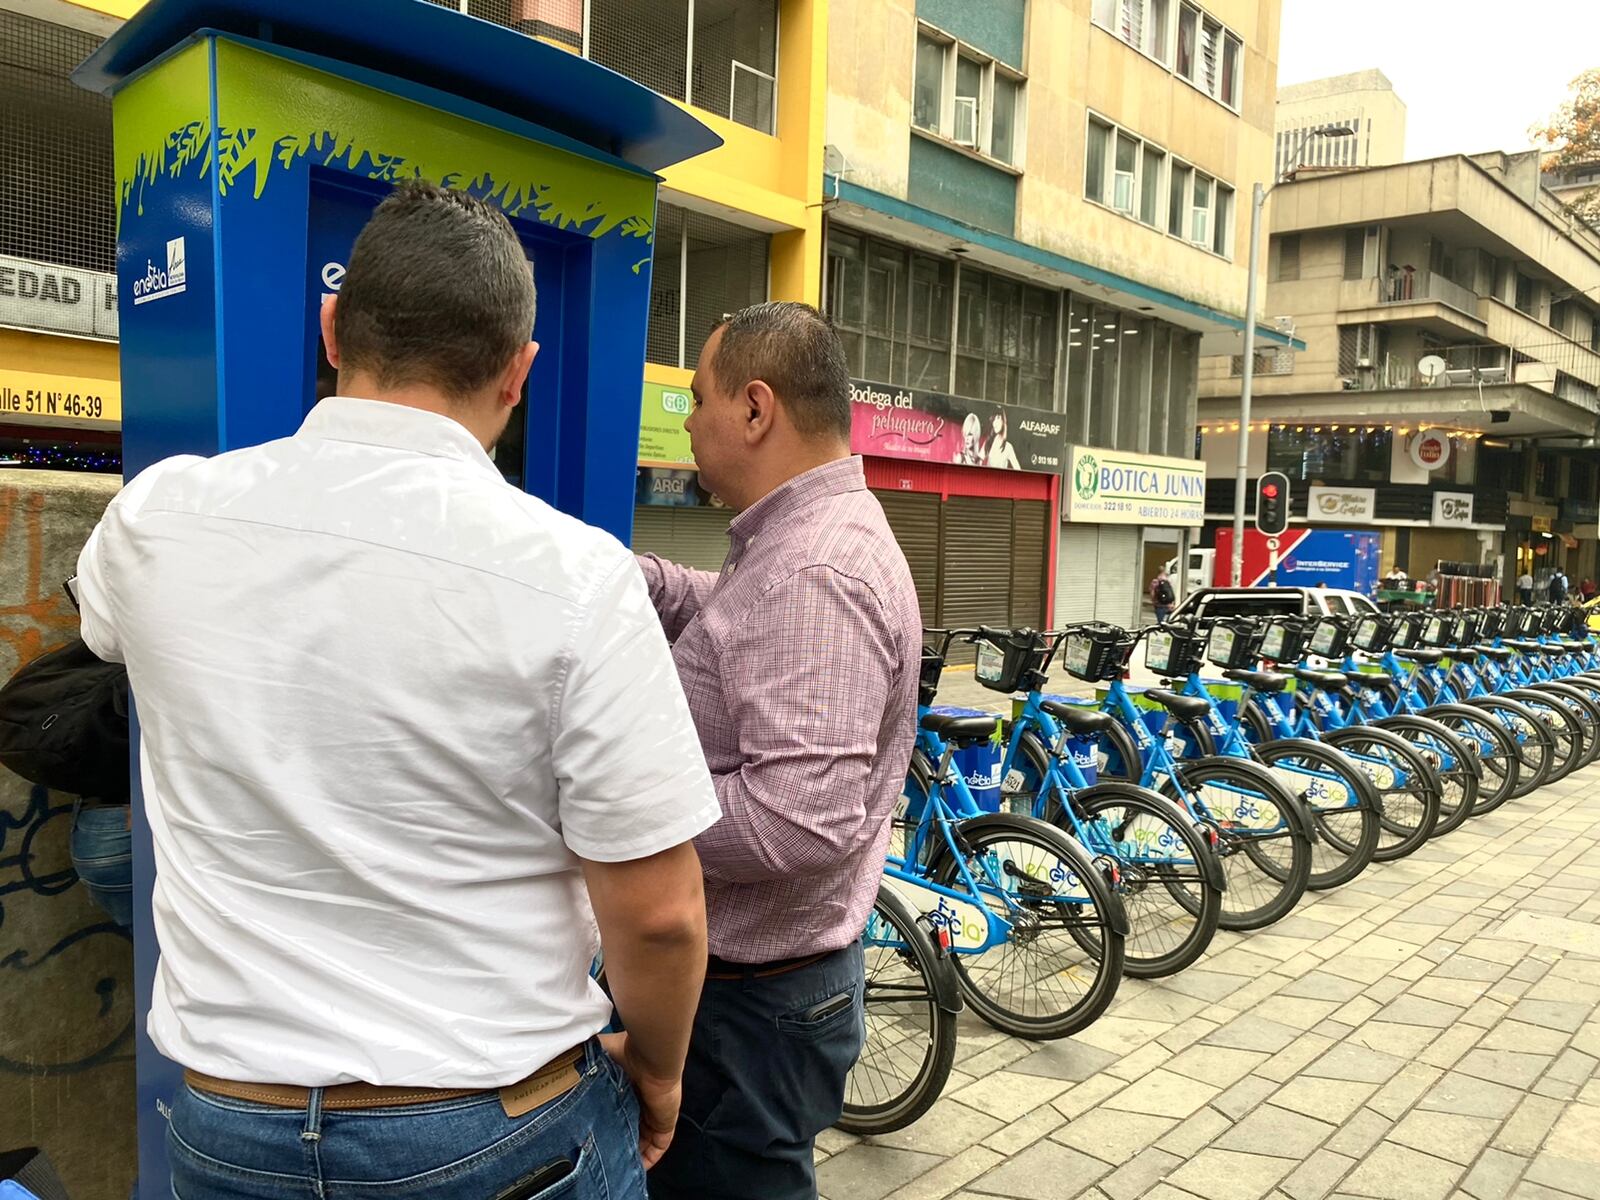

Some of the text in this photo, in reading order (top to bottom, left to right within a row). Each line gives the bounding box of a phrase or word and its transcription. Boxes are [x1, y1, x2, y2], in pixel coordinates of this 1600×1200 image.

[26, 390, 42, 412] 51
[64, 394, 102, 418] 46-39
[849, 383, 913, 411] Bodega del
[1019, 420, 1061, 435] ALFAPARF
[1100, 467, 1203, 497] BOTICA JUNIN
[1104, 501, 1117, 511] 322
[1138, 506, 1203, 521] ABIERTO 24 HORAS
